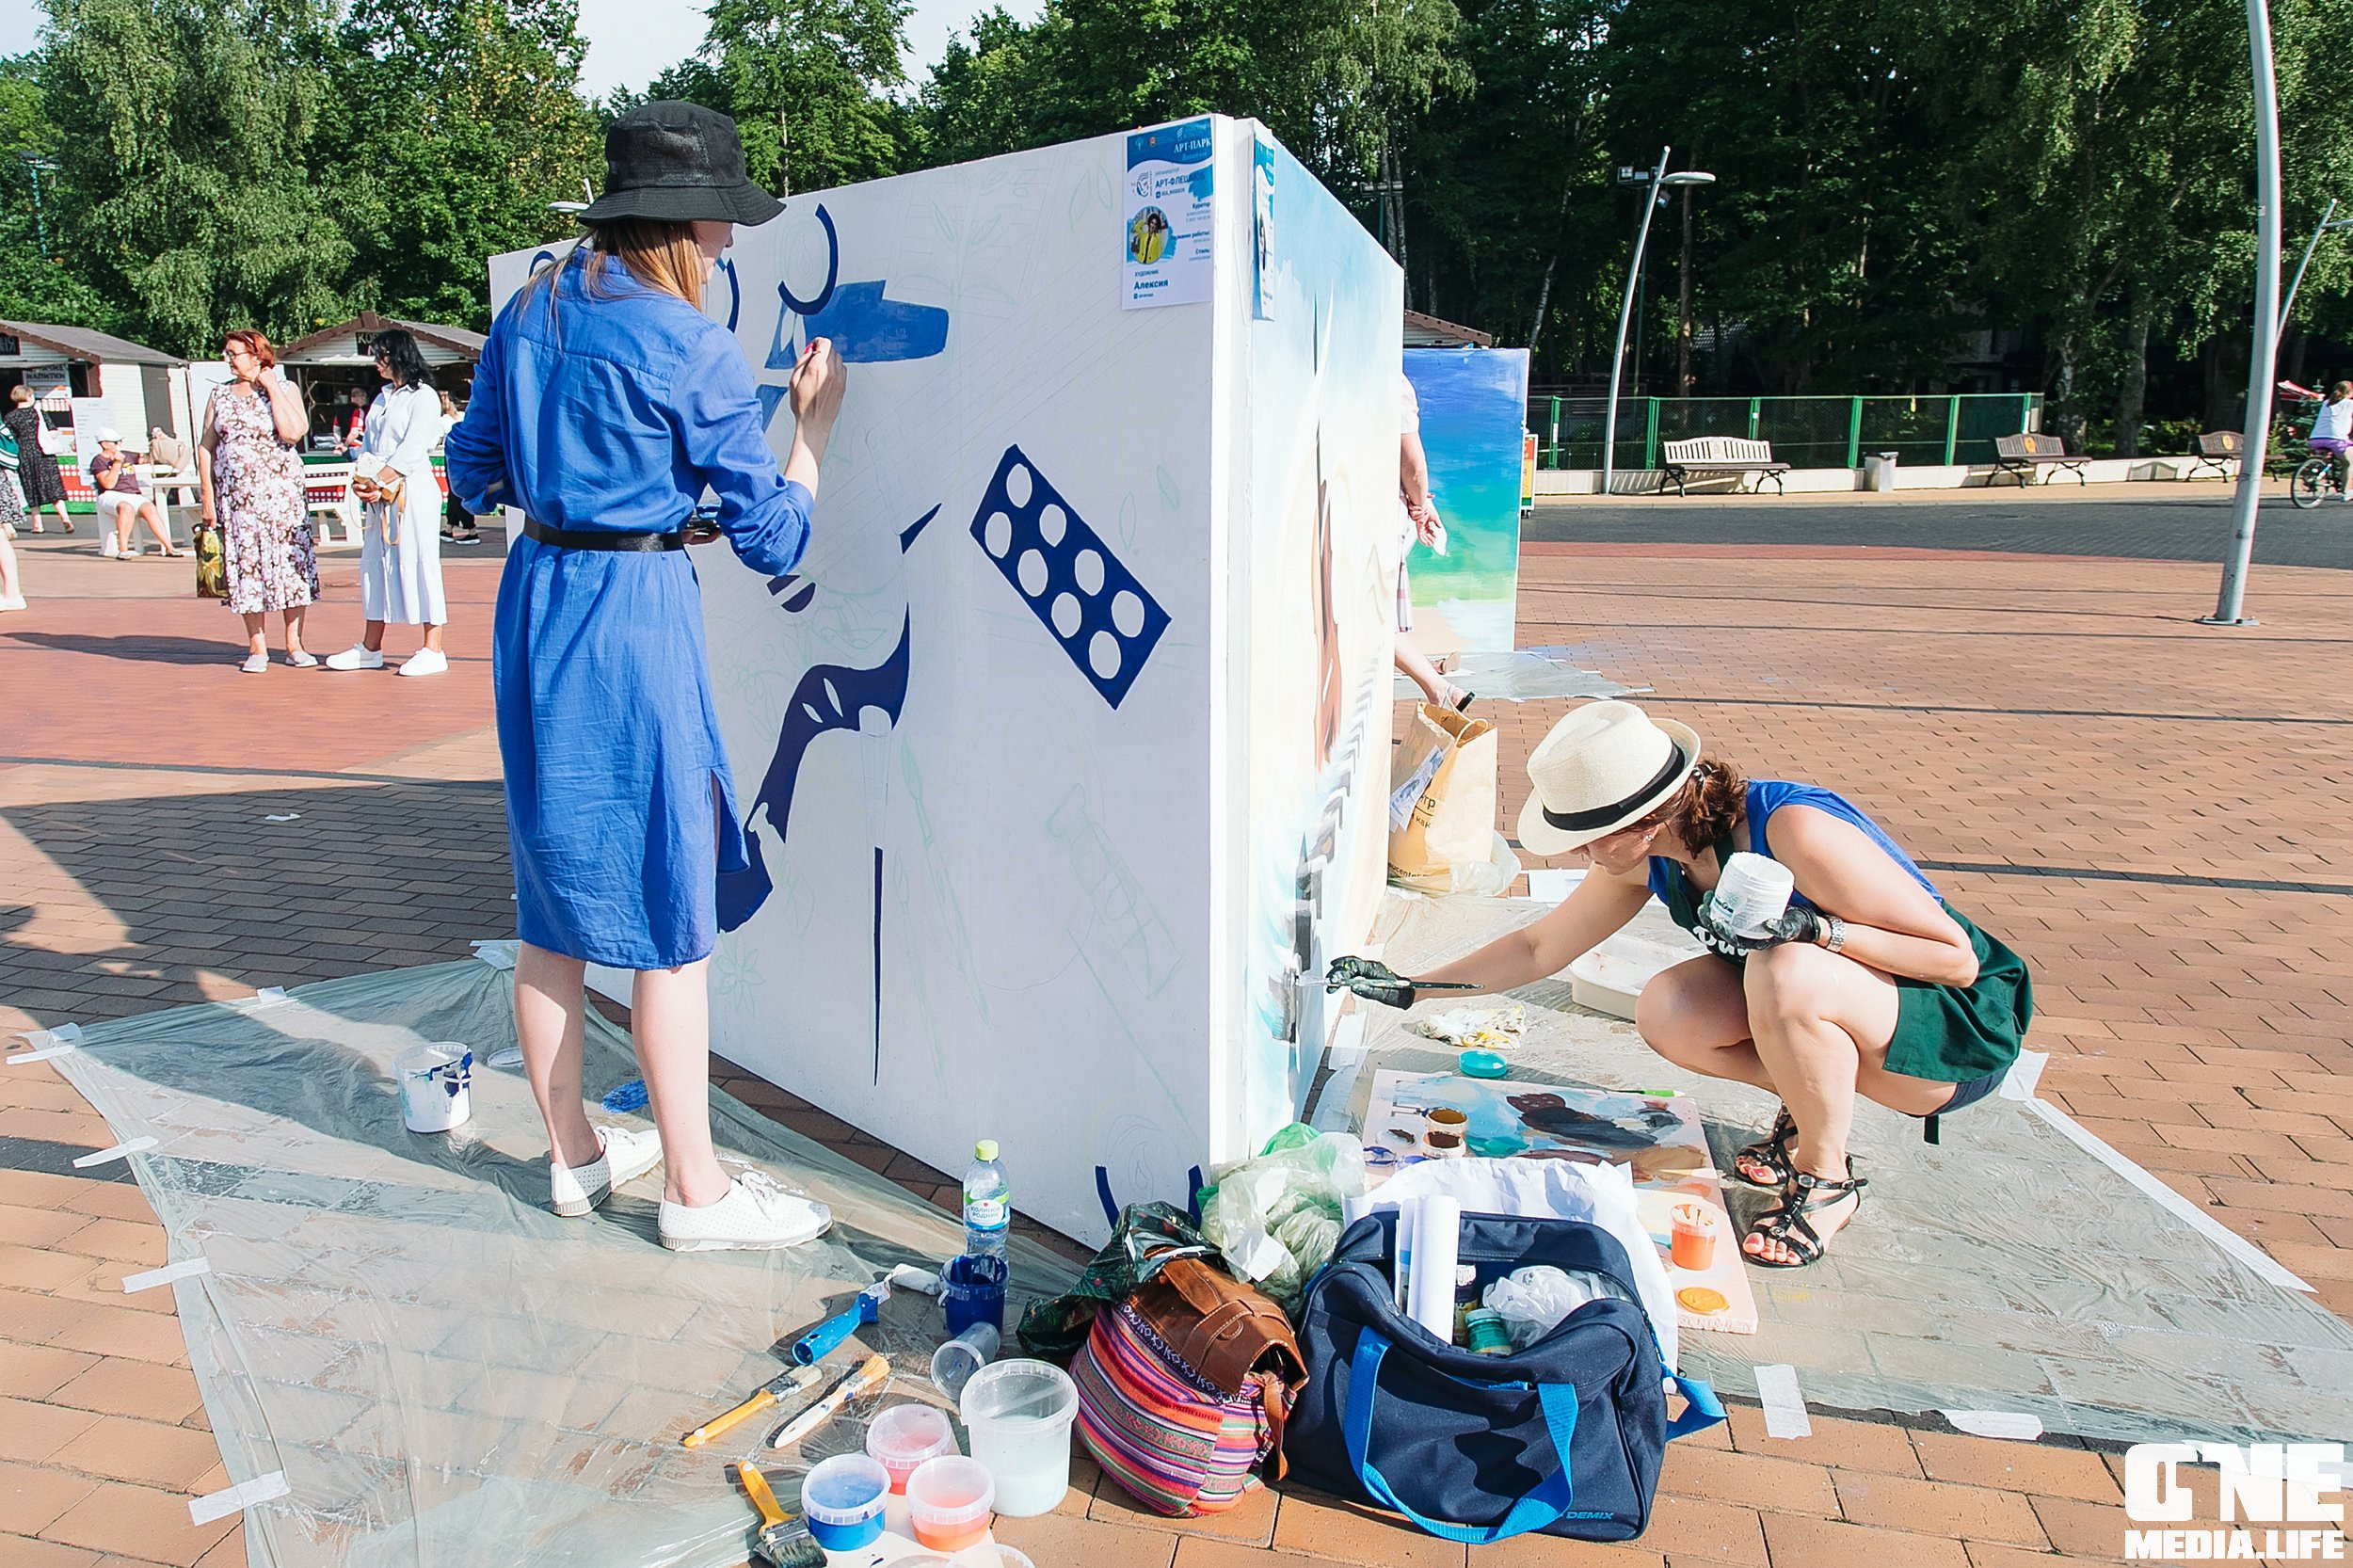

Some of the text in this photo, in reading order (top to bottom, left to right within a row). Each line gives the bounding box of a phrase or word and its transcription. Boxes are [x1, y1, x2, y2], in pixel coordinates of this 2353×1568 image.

[1174, 136, 1212, 153] АРТ-ПАРК
[1134, 280, 1168, 290] Алексия
[1566, 1512, 1614, 1520] DEMIX
